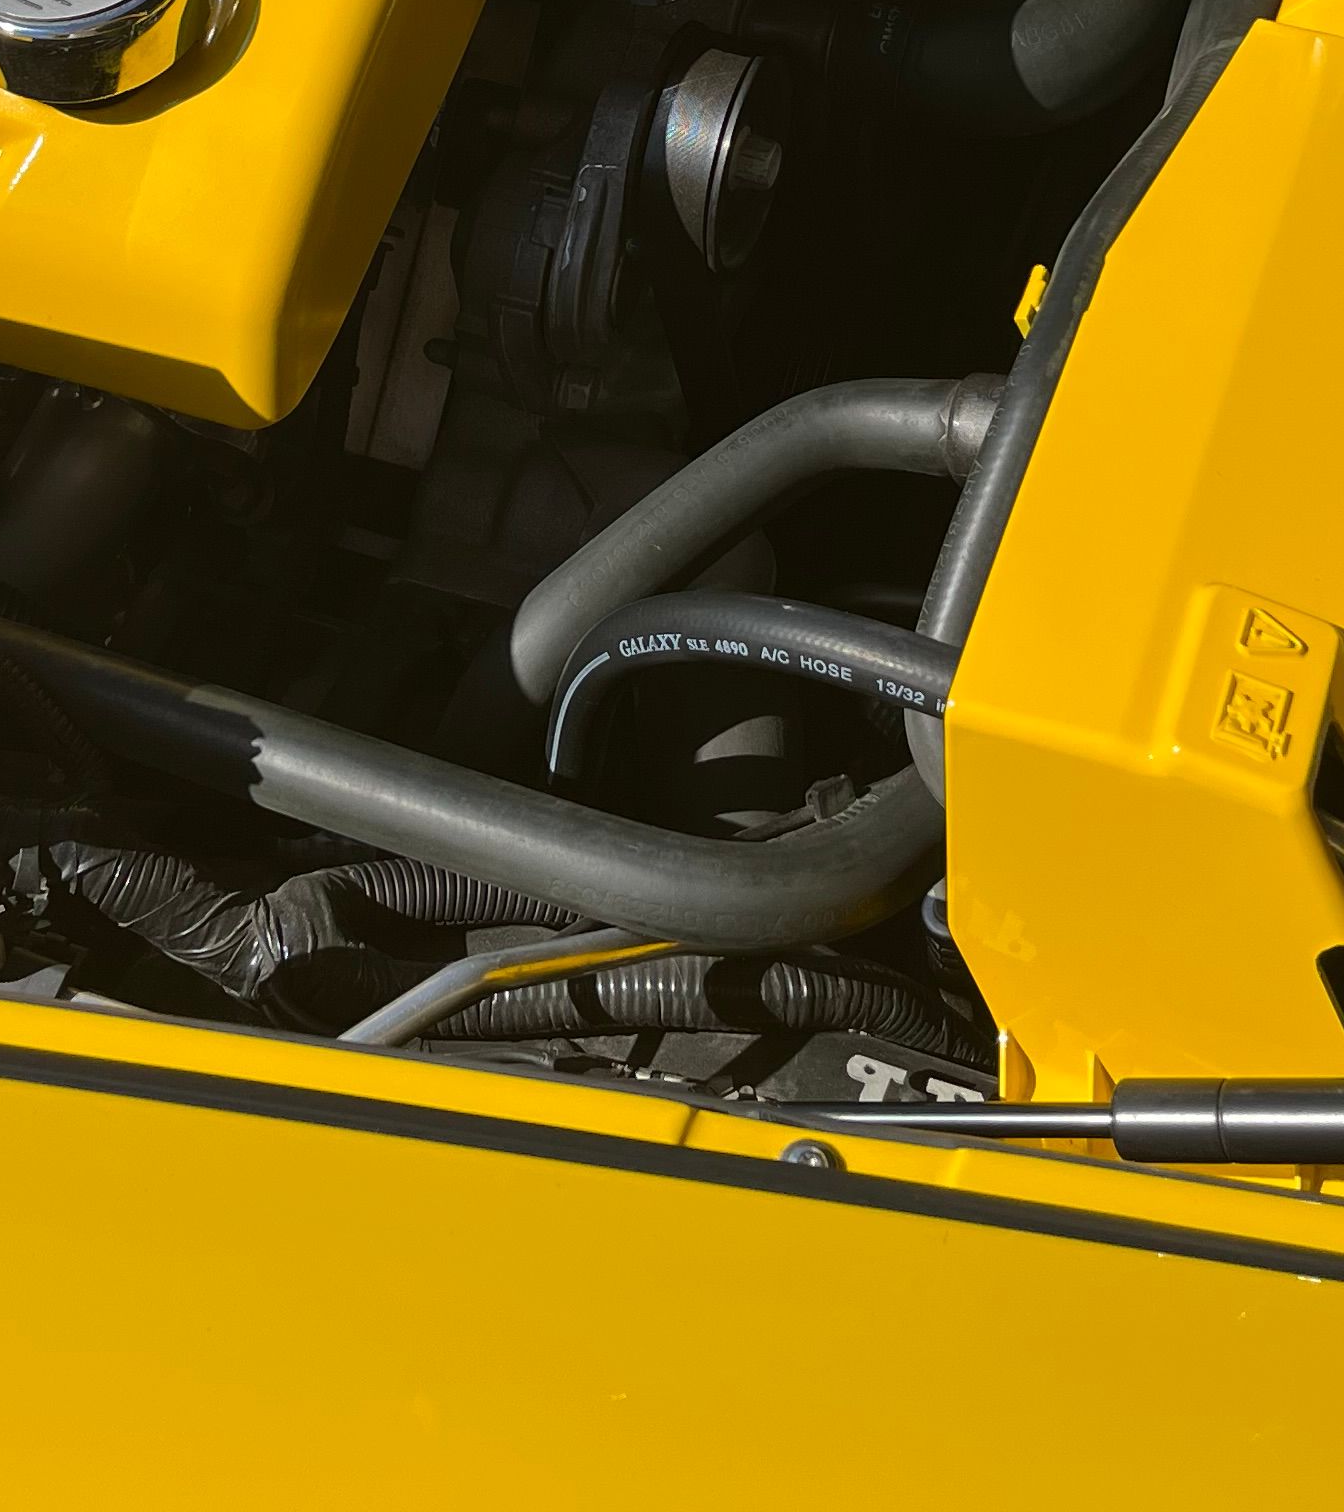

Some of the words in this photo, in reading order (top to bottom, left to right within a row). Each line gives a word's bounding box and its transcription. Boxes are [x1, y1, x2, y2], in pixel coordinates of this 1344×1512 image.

[618, 632, 682, 658] GALAXY
[714, 640, 749, 657] 4890
[760, 646, 791, 666] A/C
[799, 654, 854, 683] HOSE
[875, 678, 926, 707] 13/32
